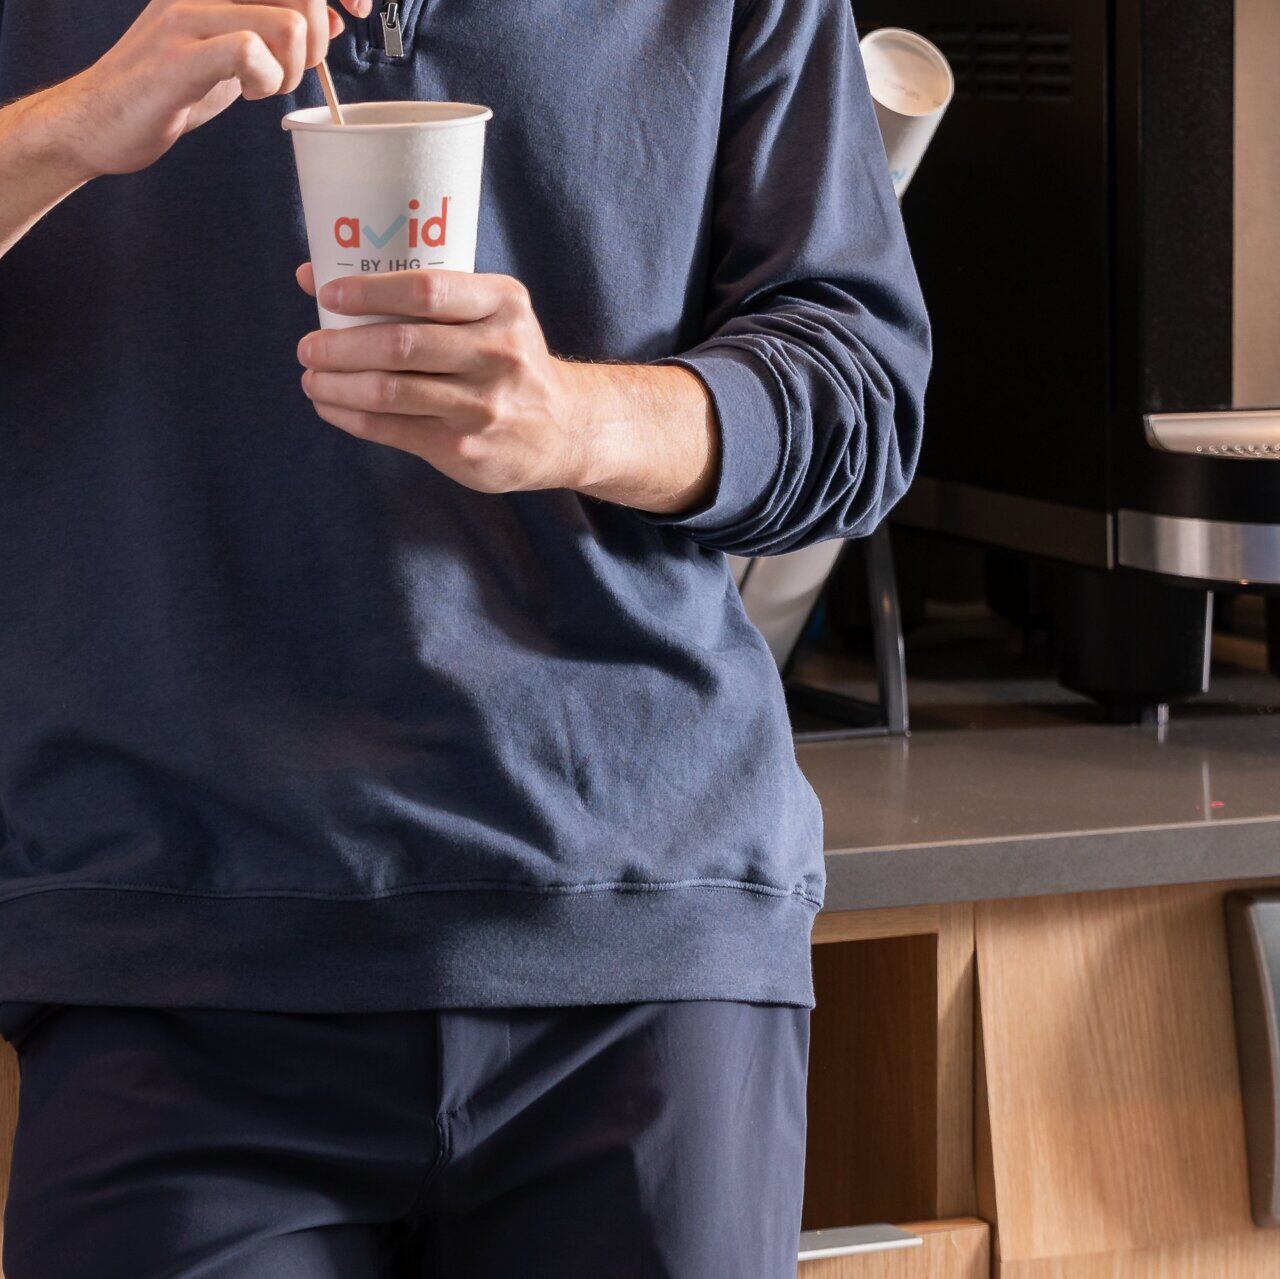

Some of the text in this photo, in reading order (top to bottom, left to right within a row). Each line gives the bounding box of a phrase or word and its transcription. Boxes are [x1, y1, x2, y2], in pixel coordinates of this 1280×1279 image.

[333, 195, 451, 250] avid
[360, 258, 421, 271] BY IHG
